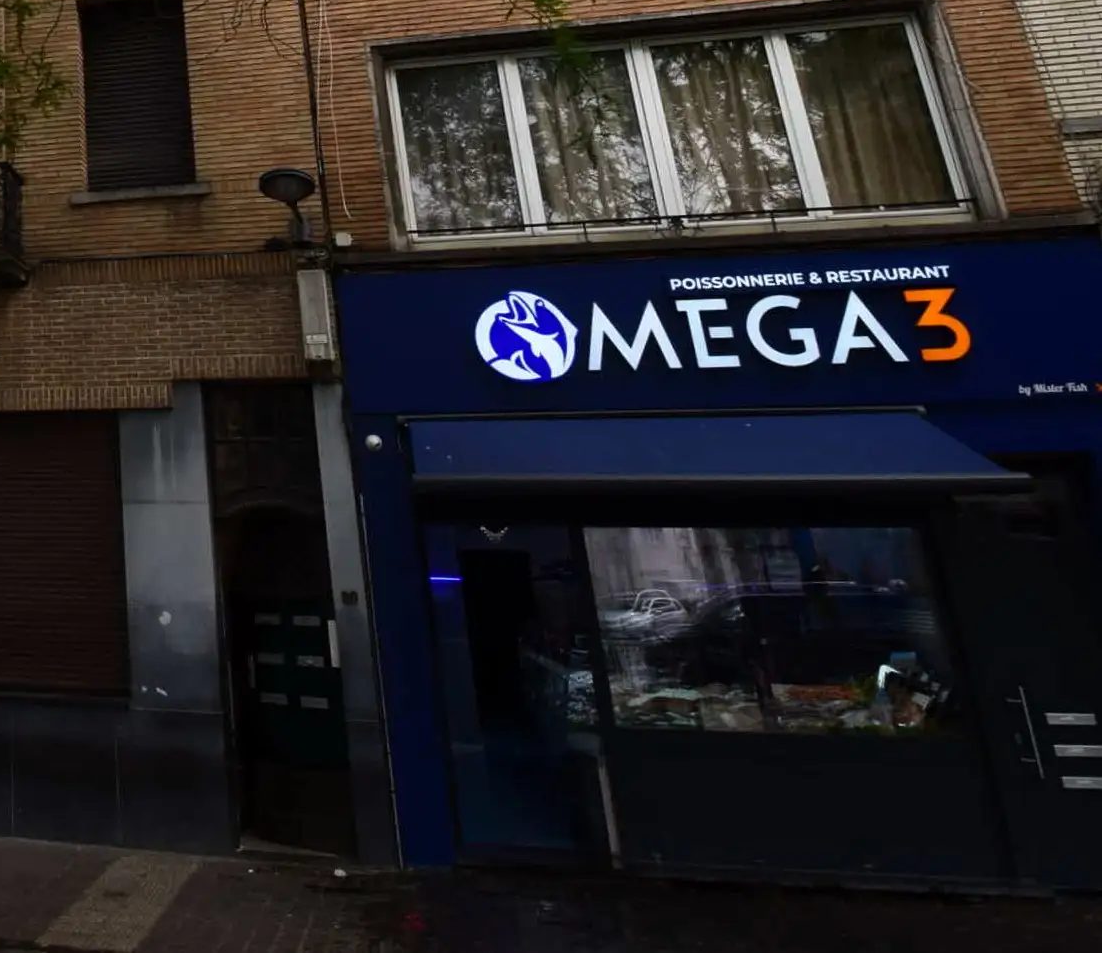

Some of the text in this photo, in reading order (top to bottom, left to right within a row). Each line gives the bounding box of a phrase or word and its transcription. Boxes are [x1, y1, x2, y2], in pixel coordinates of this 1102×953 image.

[669, 265, 951, 291] POISSONNERIE & RESTAURANT
[1017, 382, 1088, 396] by Mister Fish
